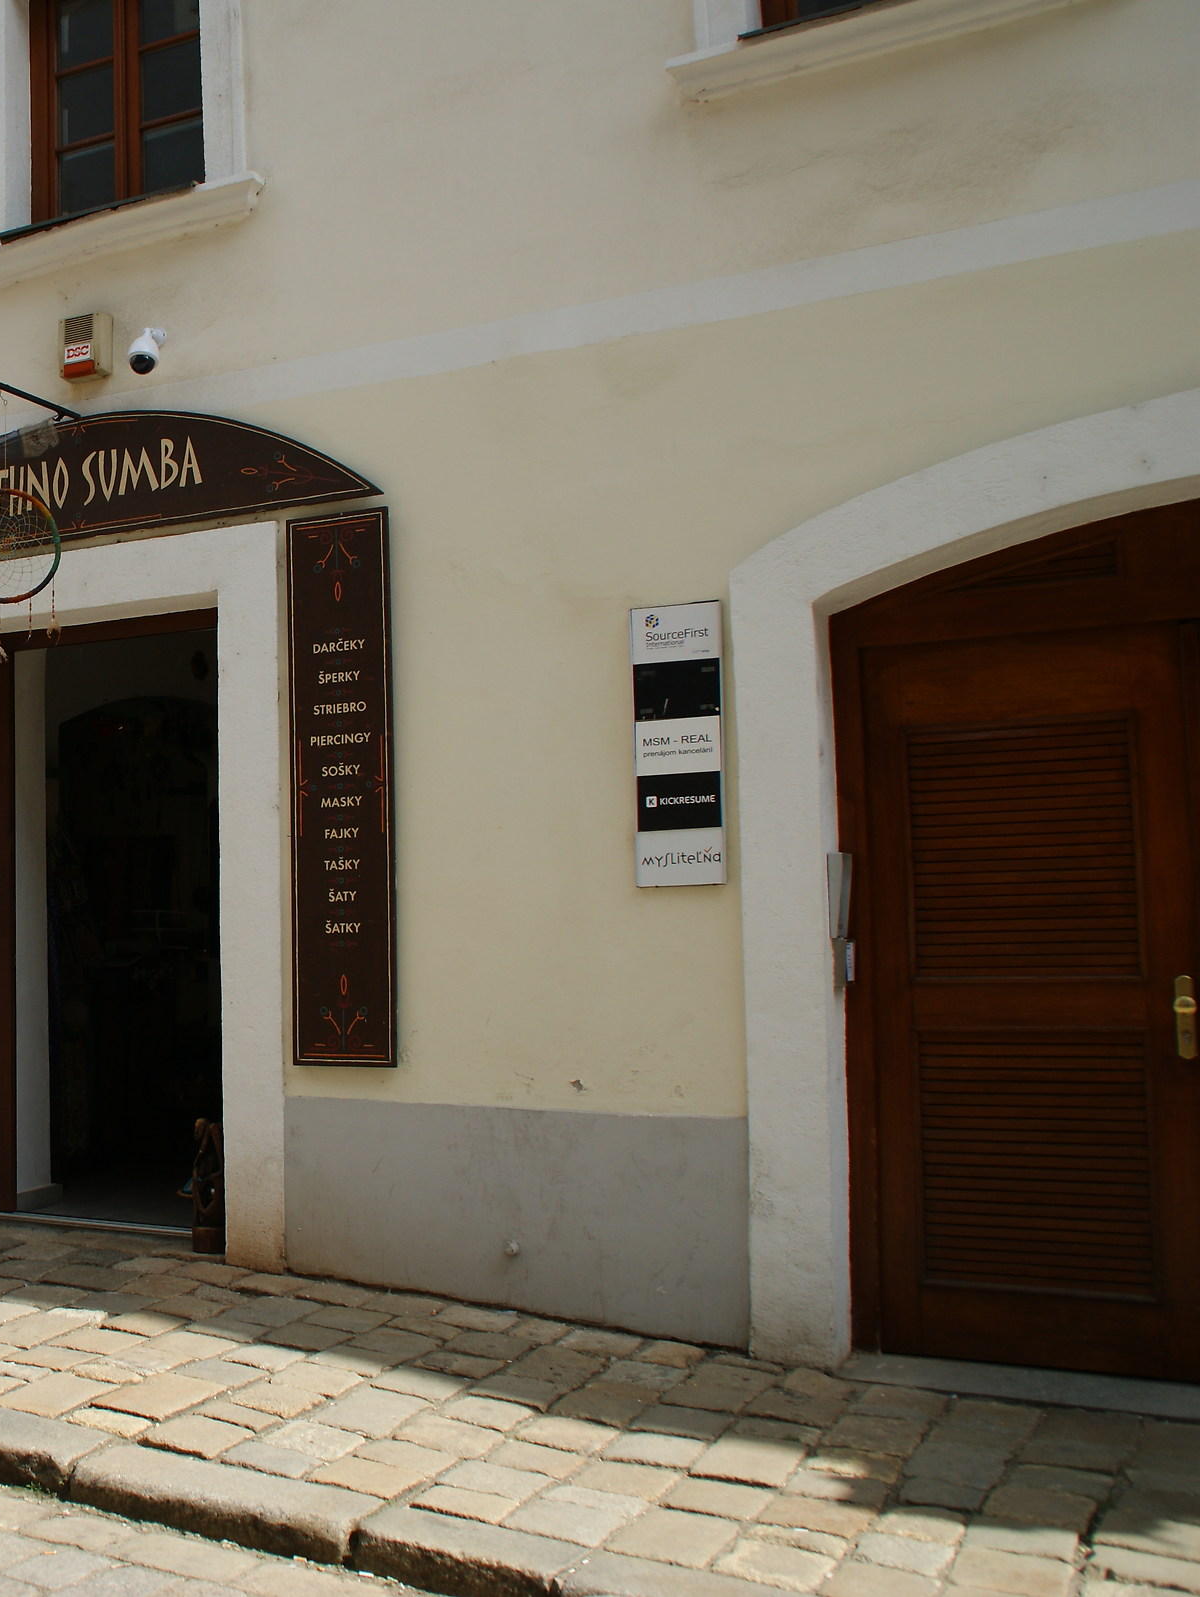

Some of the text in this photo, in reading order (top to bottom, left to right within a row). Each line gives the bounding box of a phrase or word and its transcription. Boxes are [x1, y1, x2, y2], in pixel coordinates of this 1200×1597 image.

[67, 345, 89, 359] DSC
[82, 436, 203, 507] SUMBA
[645, 627, 709, 642] SourceFirst
[312, 638, 365, 654] DARČEKY
[646, 639, 684, 648] International
[318, 670, 360, 684] ŠPERKY
[313, 701, 367, 716] STRIEBRO
[310, 732, 371, 747] PIERCINGY
[642, 737, 670, 747] MSM
[680, 734, 712, 744] REAL
[643, 749, 676, 758] prenájom
[321, 763, 361, 777] SOŠKY
[320, 795, 362, 809] MASKY
[659, 794, 716, 806] KICKRESUME
[324, 827, 359, 840] FAJKY
[324, 857, 360, 871] TAŠKY
[328, 888, 357, 903] ŠATY
[325, 920, 361, 934] ŠATKY
